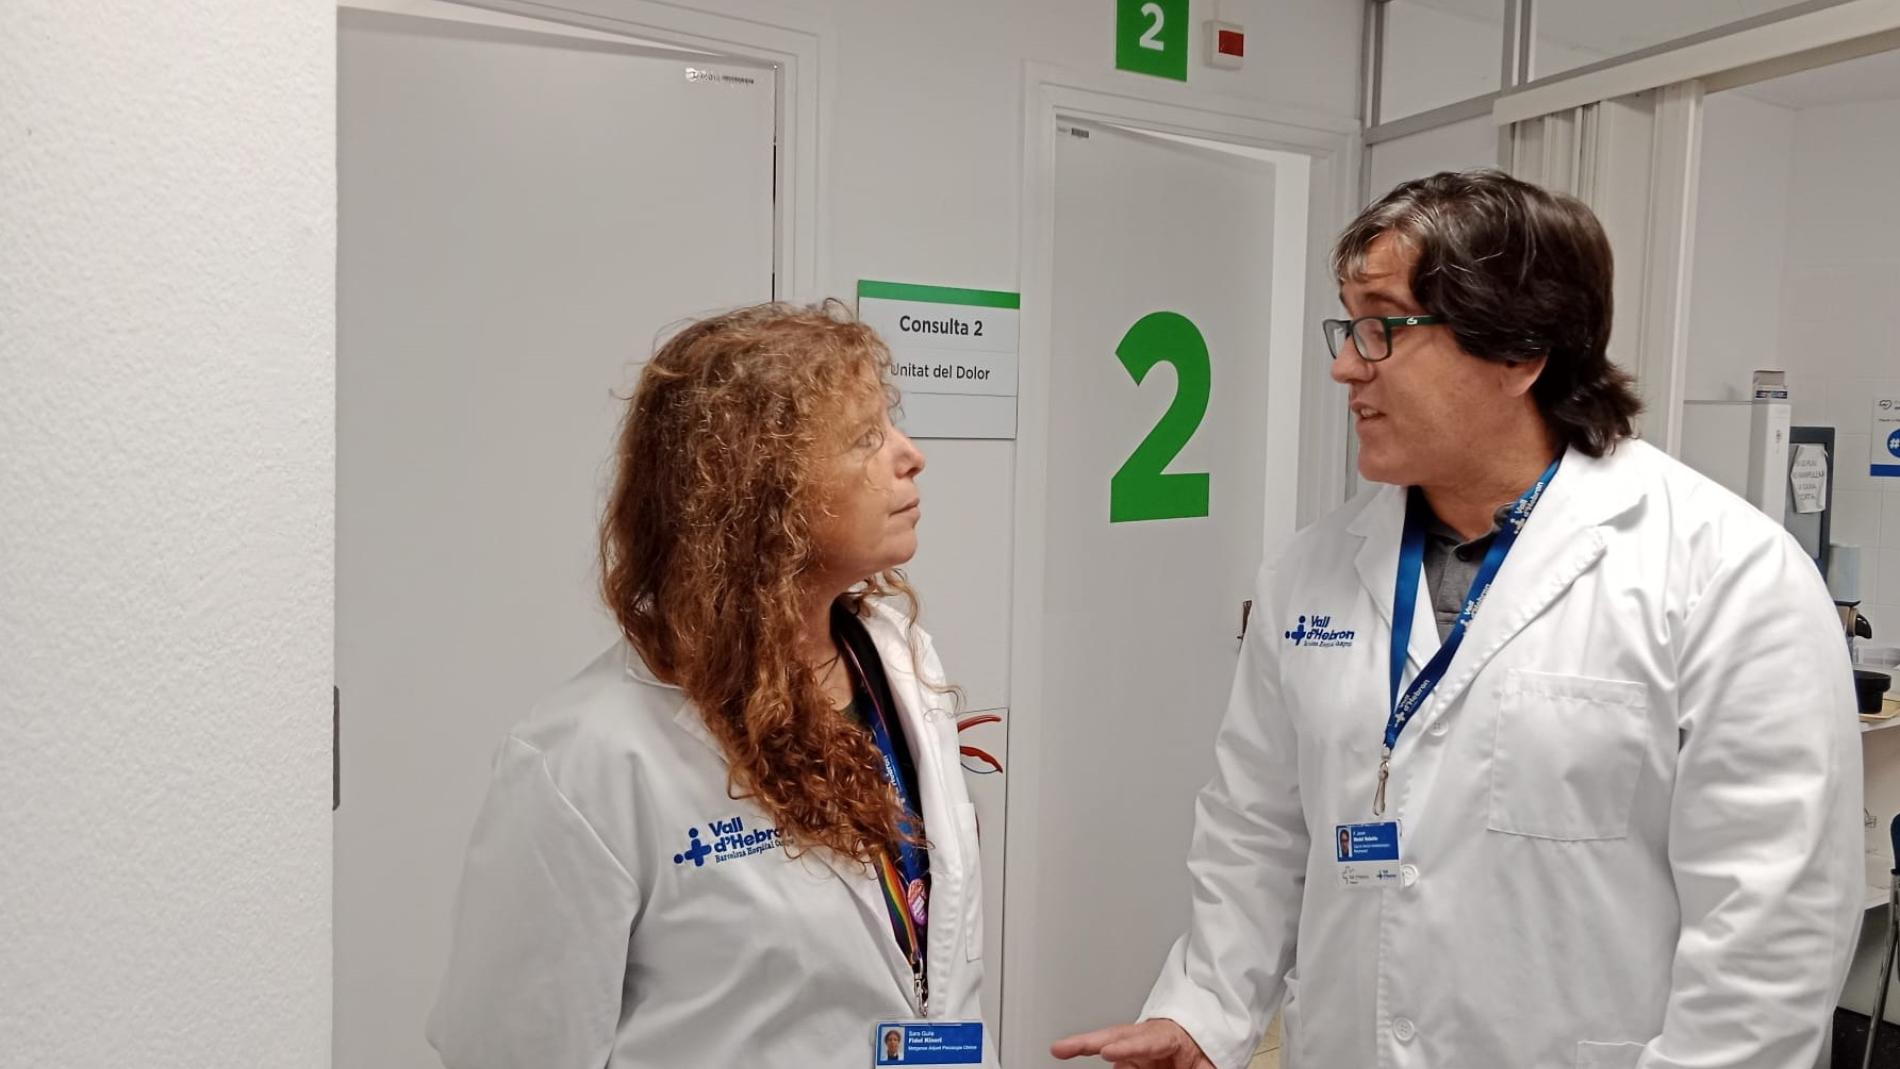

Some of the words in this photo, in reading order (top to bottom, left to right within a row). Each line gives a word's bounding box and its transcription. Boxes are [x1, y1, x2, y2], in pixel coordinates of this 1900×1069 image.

[1139, 2, 1165, 51] 2
[899, 314, 969, 336] Consulta
[973, 320, 984, 337] 2
[890, 362, 929, 378] Unitat
[933, 365, 952, 379] del
[956, 366, 991, 380] Dolor
[1110, 311, 1212, 523] 2
[1311, 615, 1330, 628] Vall
[708, 816, 744, 837] Vall
[714, 827, 782, 853] d'Hebro
